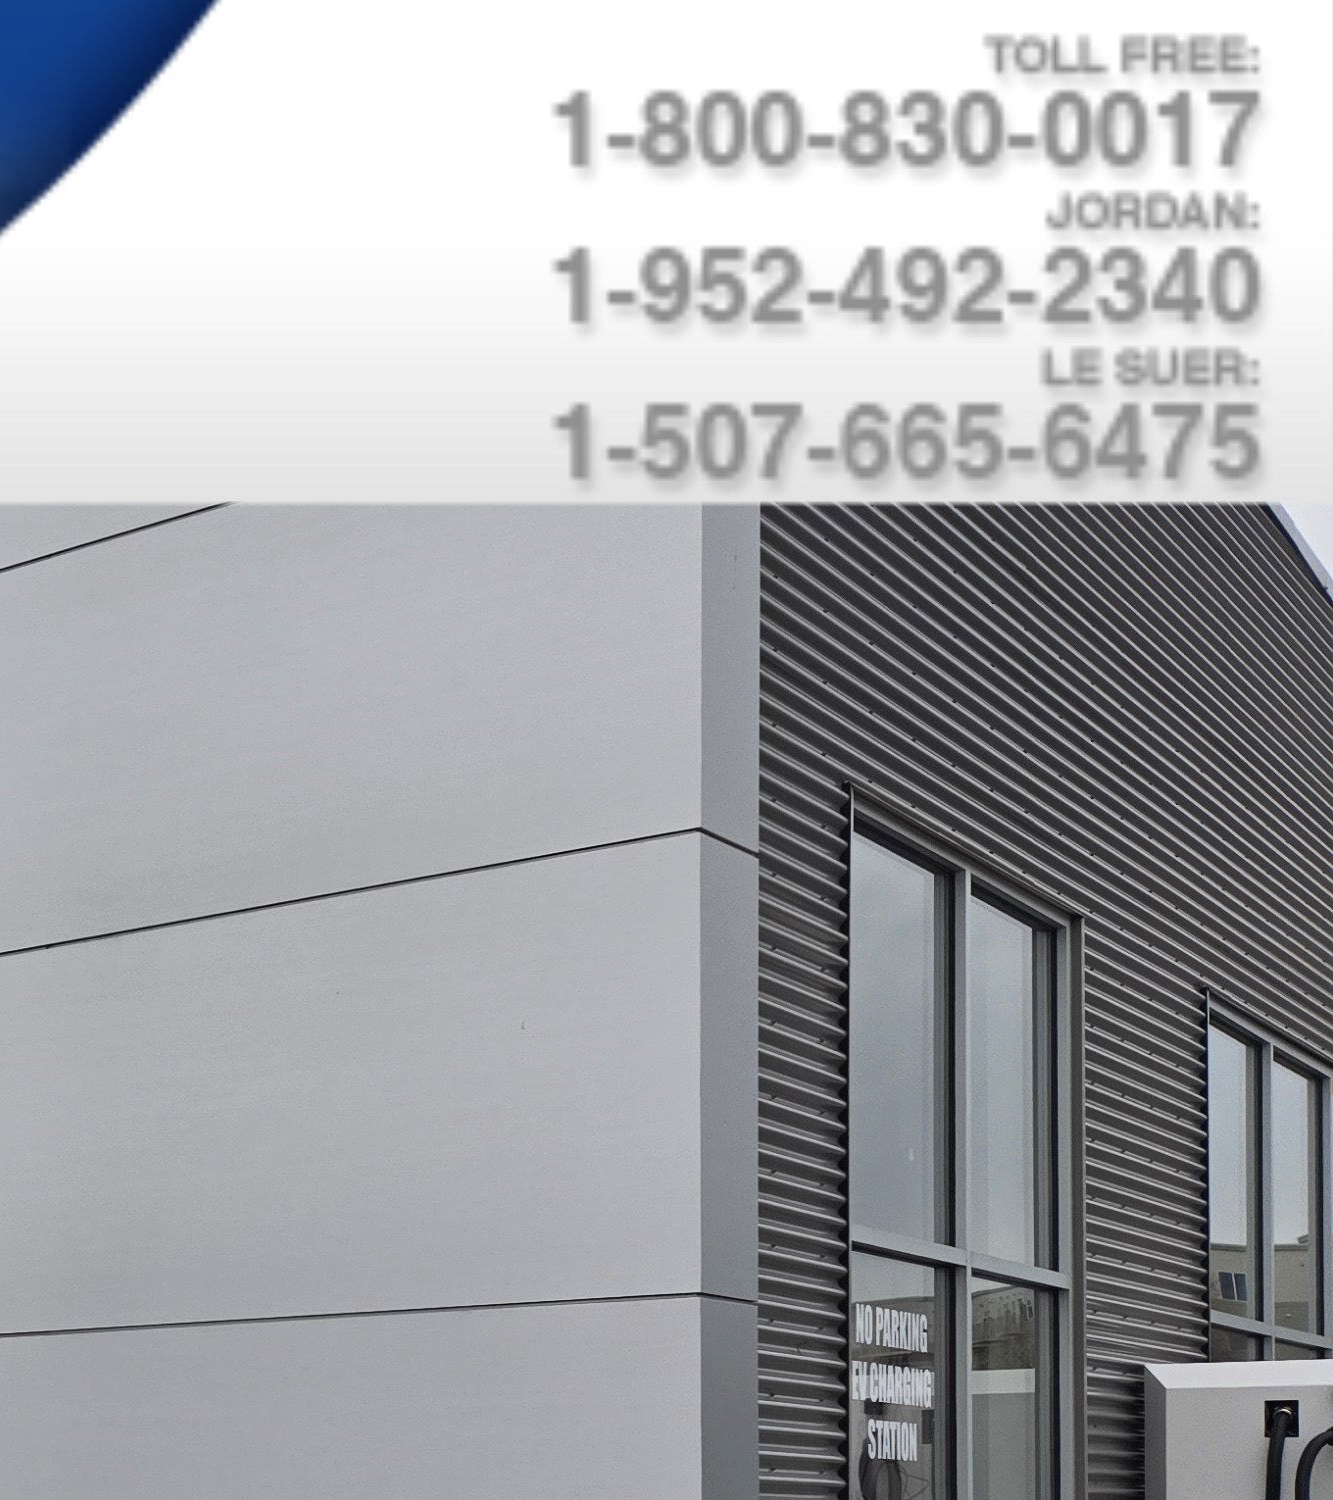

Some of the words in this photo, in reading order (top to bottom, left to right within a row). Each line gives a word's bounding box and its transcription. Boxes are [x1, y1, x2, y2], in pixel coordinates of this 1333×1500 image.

[855, 1302, 873, 1345] NO
[875, 1306, 928, 1353] PARKING
[851, 1360, 867, 1401] EV
[869, 1362, 932, 1408] CHARGING
[867, 1418, 918, 1462] STATION
